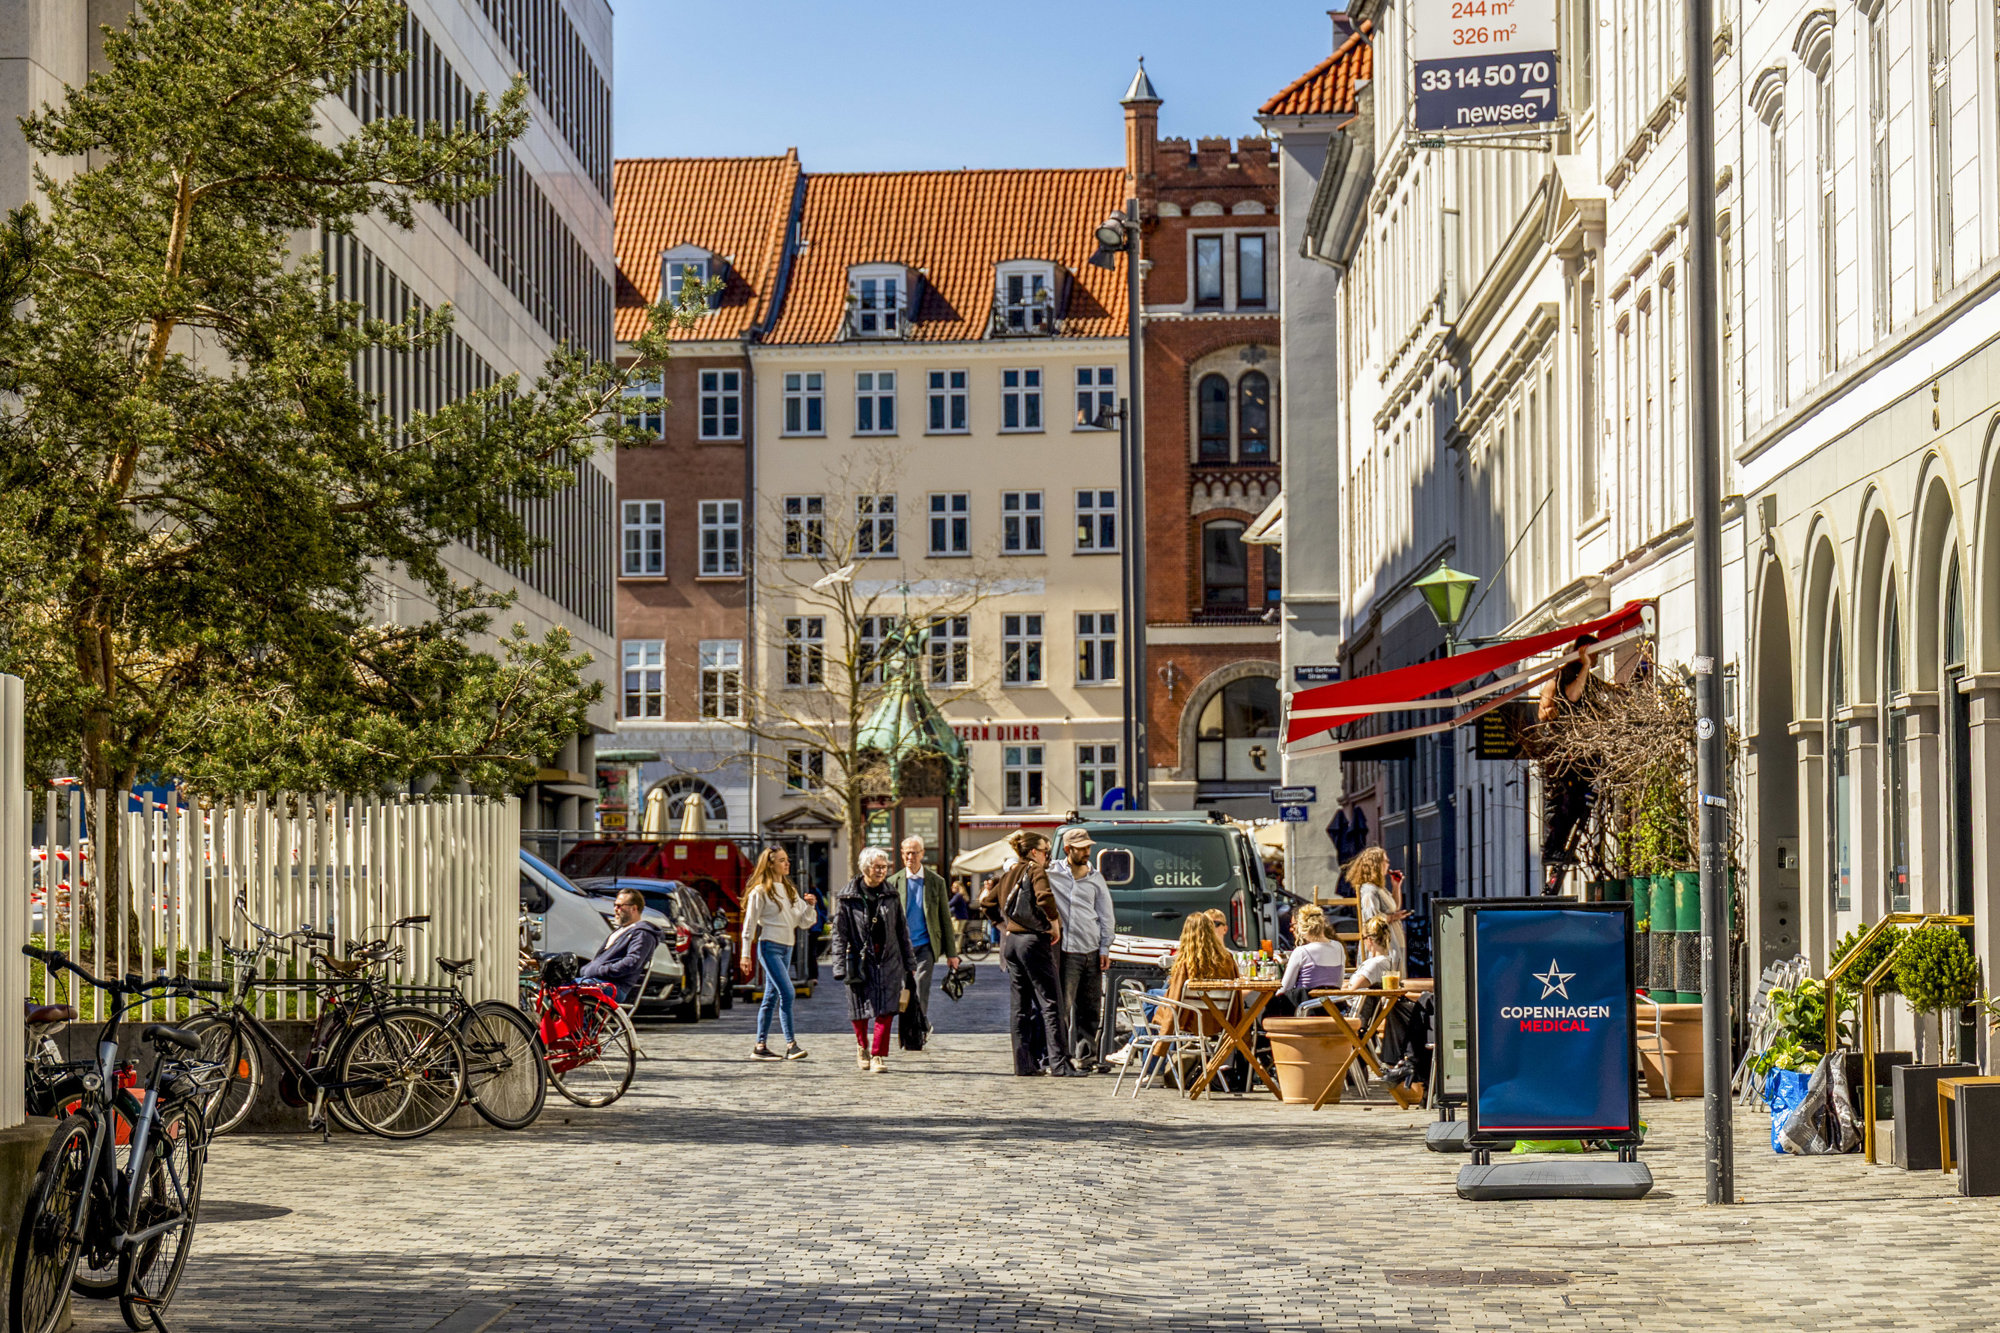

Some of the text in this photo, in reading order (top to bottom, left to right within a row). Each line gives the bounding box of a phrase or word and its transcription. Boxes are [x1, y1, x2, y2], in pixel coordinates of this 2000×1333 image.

[1452, 1, 1487, 19] 244
[1453, 27, 1488, 45] 326
[1421, 61, 1550, 91] 33 14 50 70
[1457, 102, 1538, 124] newsec
[996, 725, 1041, 741] DINER
[1154, 871, 1203, 886] etikk
[1114, 924, 1133, 933] iser
[1500, 1005, 1610, 1019] COPENHAGEN
[1520, 1019, 1590, 1033] MEDICAL
